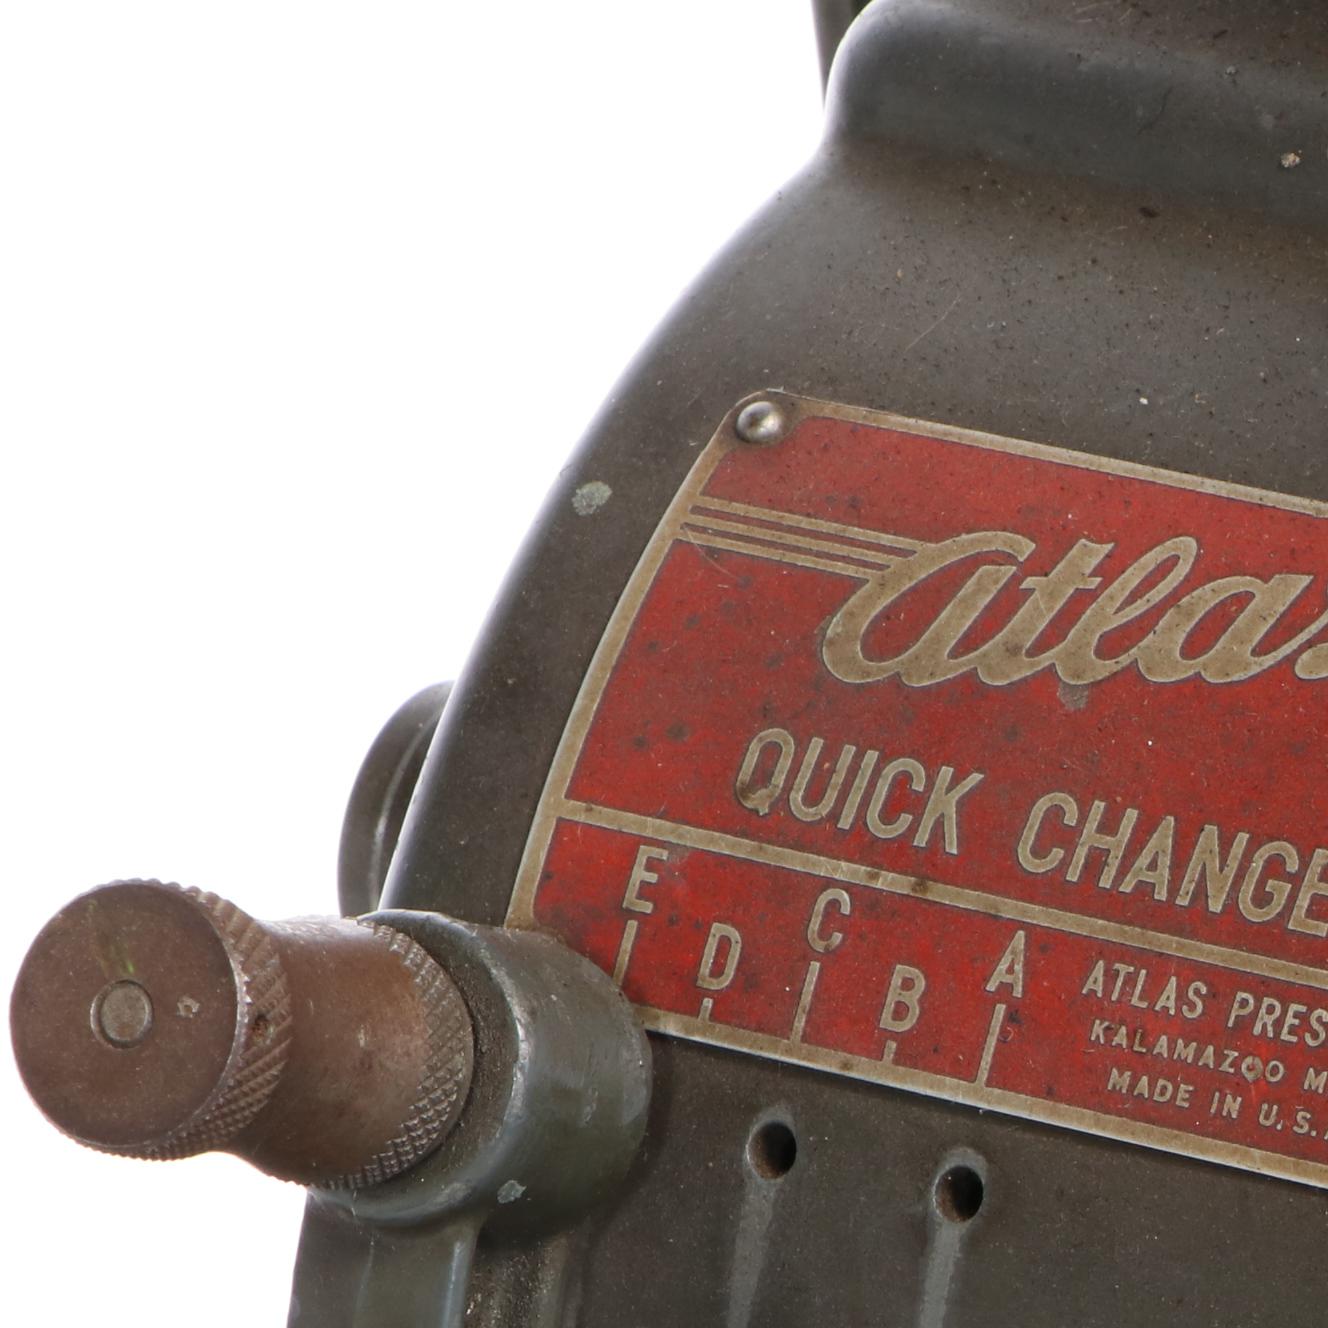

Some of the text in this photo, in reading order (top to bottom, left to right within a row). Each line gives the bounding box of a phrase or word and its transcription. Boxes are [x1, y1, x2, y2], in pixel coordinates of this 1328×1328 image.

[734, 729, 984, 856] QUICK
[624, 846, 1027, 1031] E D C B A
[1080, 961, 1209, 1021] ATLAS
[1090, 1019, 1286, 1085] KALAMAZOO
[1107, 1068, 1192, 1107] MADE
[1211, 1090, 1241, 1118] IN
